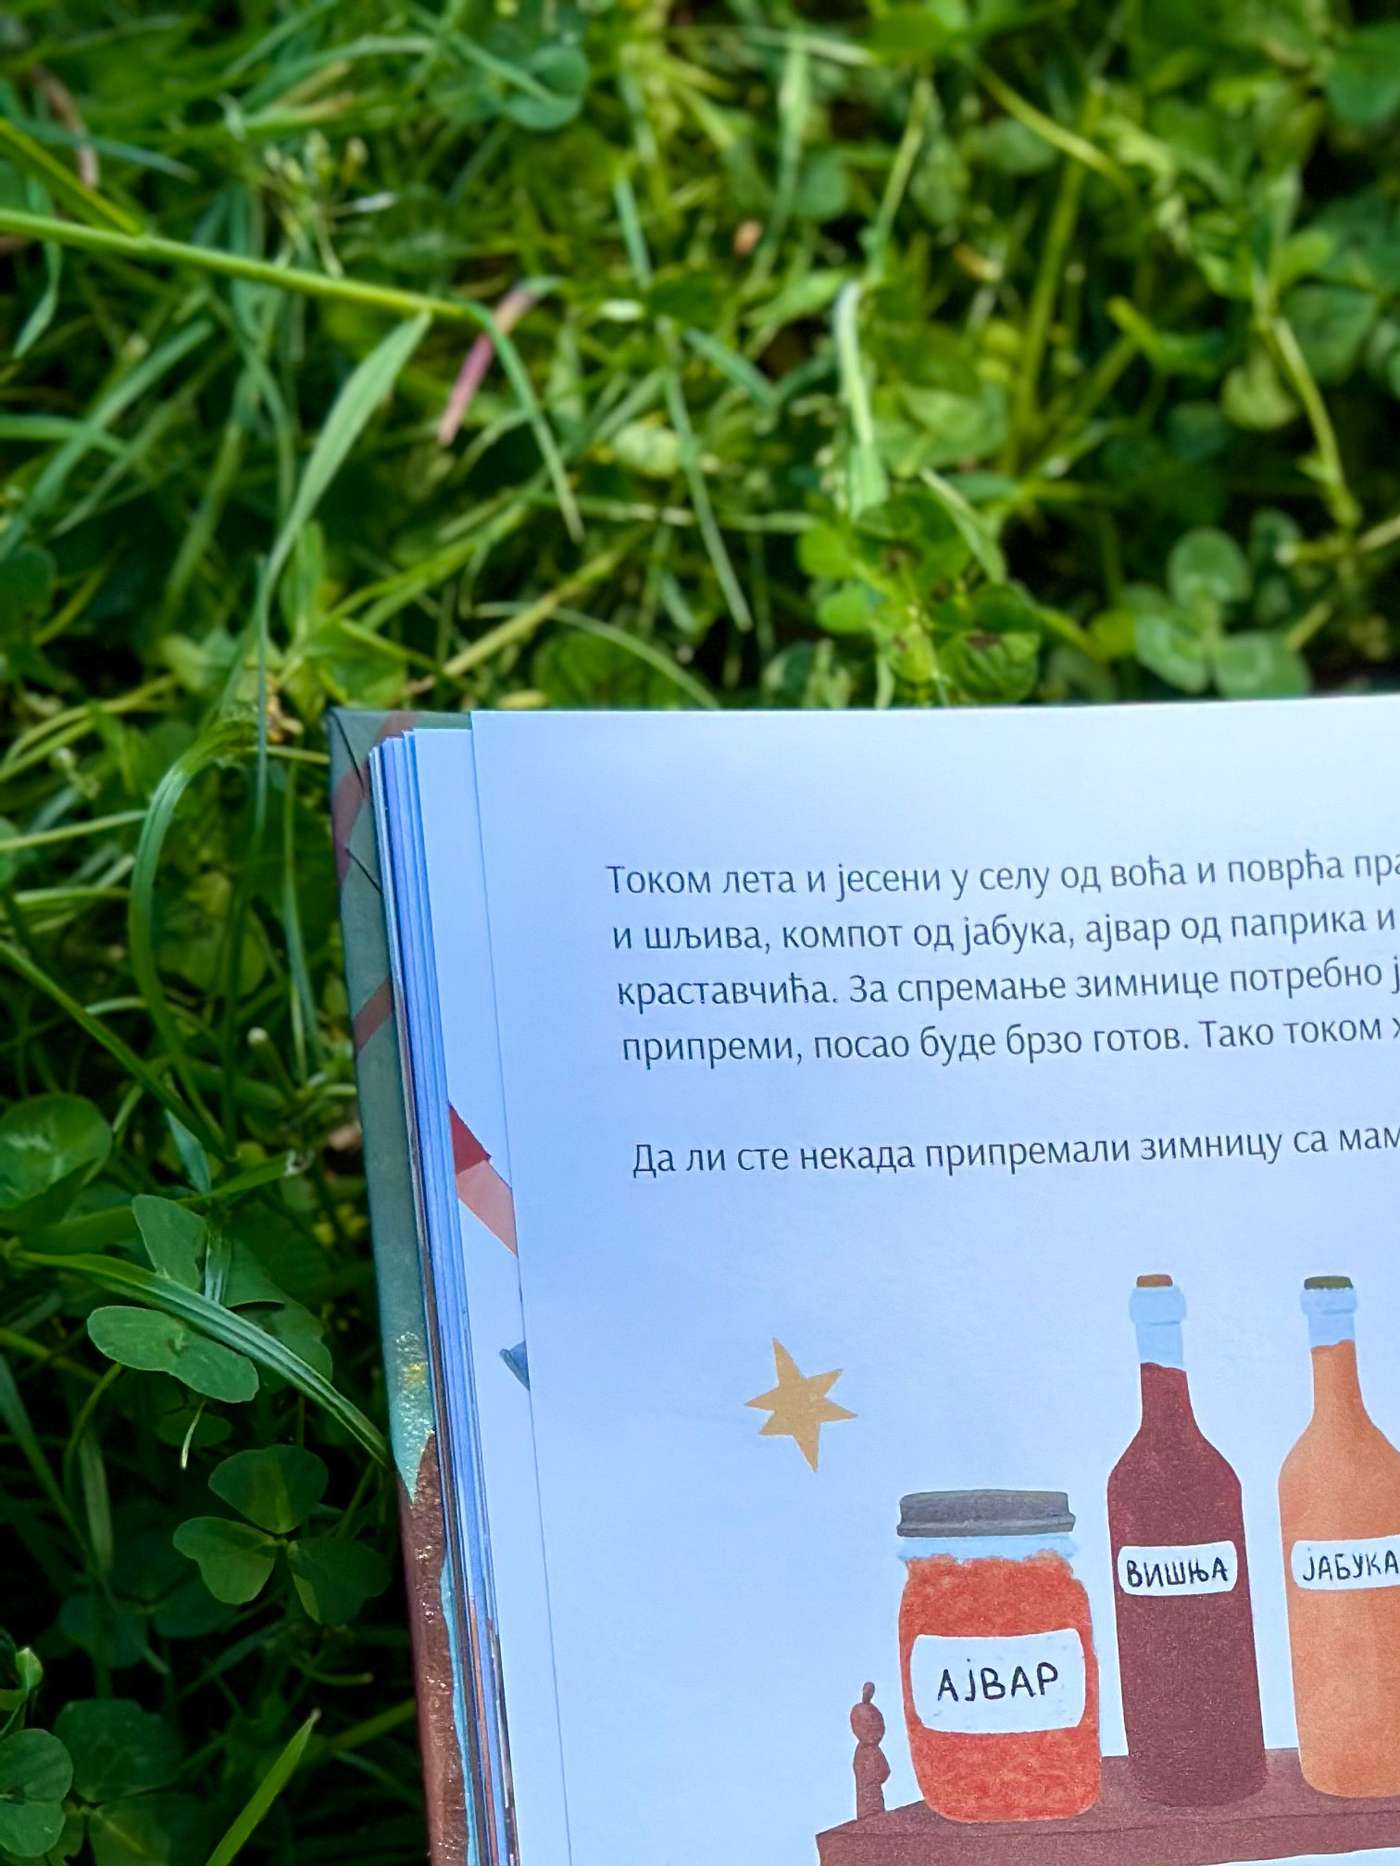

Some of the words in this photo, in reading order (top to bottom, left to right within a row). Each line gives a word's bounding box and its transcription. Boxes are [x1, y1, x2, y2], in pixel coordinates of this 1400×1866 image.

[606, 866, 710, 893] Током
[723, 871, 796, 893] лета
[808, 871, 825, 892] и
[836, 864, 940, 902] јесени
[951, 869, 968, 900] у
[980, 867, 1049, 899] селу
[1061, 866, 1101, 893] од
[1111, 855, 1186, 886] воћа
[1198, 863, 1215, 884] и
[1228, 849, 1344, 890] поврћа
[614, 928, 631, 949] и
[645, 927, 770, 954] шљива,
[783, 925, 902, 948] компот
[914, 925, 954, 951] од
[962, 914, 1074, 955] јабука,
[1086, 914, 1170, 952] ајвар
[1181, 917, 1221, 944] од
[1232, 911, 1366, 944] паприка
[1377, 908, 1395, 930] и
[618, 972, 837, 1014] краставчића.
[850, 975, 888, 1002] За
[898, 977, 1065, 1011] спремање
[1077, 972, 1218, 999] зимнице
[1231, 956, 1382, 999] потребно
[623, 1038, 802, 1070] припреми,
[815, 1036, 909, 1058] посао
[921, 1026, 995, 1066] буде
[1007, 1024, 1082, 1064] брзо
[1094, 1028, 1188, 1052] готов.
[1199, 1021, 1273, 1047] Тако
[1287, 1018, 1381, 1043] током
[633, 1144, 676, 1178] Да
[686, 1150, 725, 1171] ли
[738, 1149, 788, 1170] сте
[801, 1146, 915, 1173] некада
[926, 1140, 1129, 1176] припремали
[1141, 1134, 1282, 1164] зимницу
[1294, 1131, 1328, 1153] са
[1127, 1557, 1228, 1587] ВИШЊА
[1303, 1550, 1399, 1581] ЈАБУКА
[938, 1659, 1058, 1701] АЈВАР
